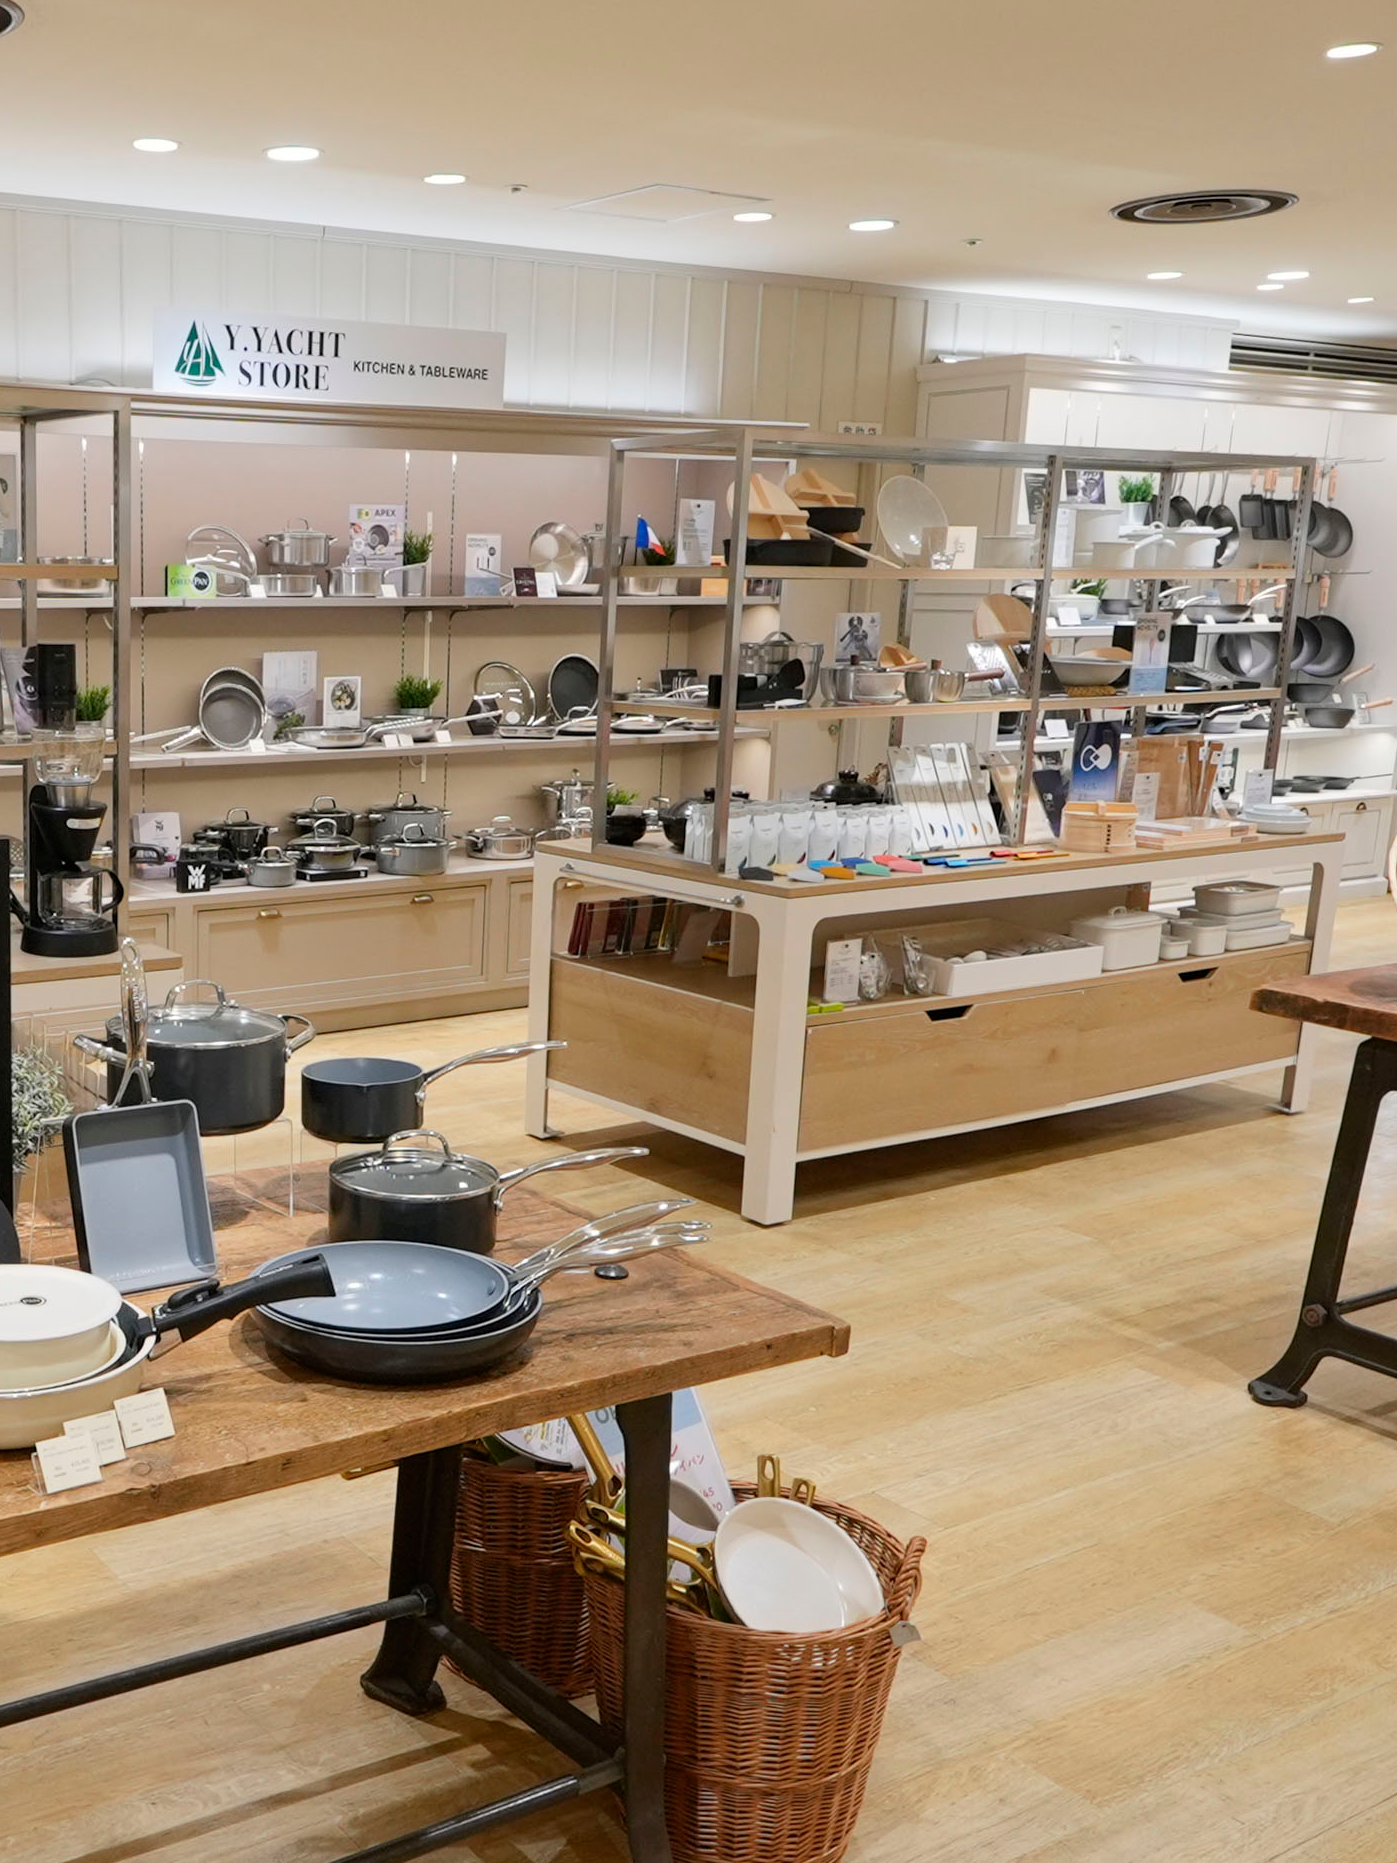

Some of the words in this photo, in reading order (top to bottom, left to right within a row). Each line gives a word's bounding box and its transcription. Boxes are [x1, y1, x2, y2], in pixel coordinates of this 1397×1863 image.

[223, 324, 345, 358] Y.YACHT
[238, 360, 330, 392] STORE
[353, 361, 404, 376] KITCHEN
[408, 364, 416, 376] &
[419, 365, 489, 381] TABLEWARE
[375, 508, 396, 517] APEX
